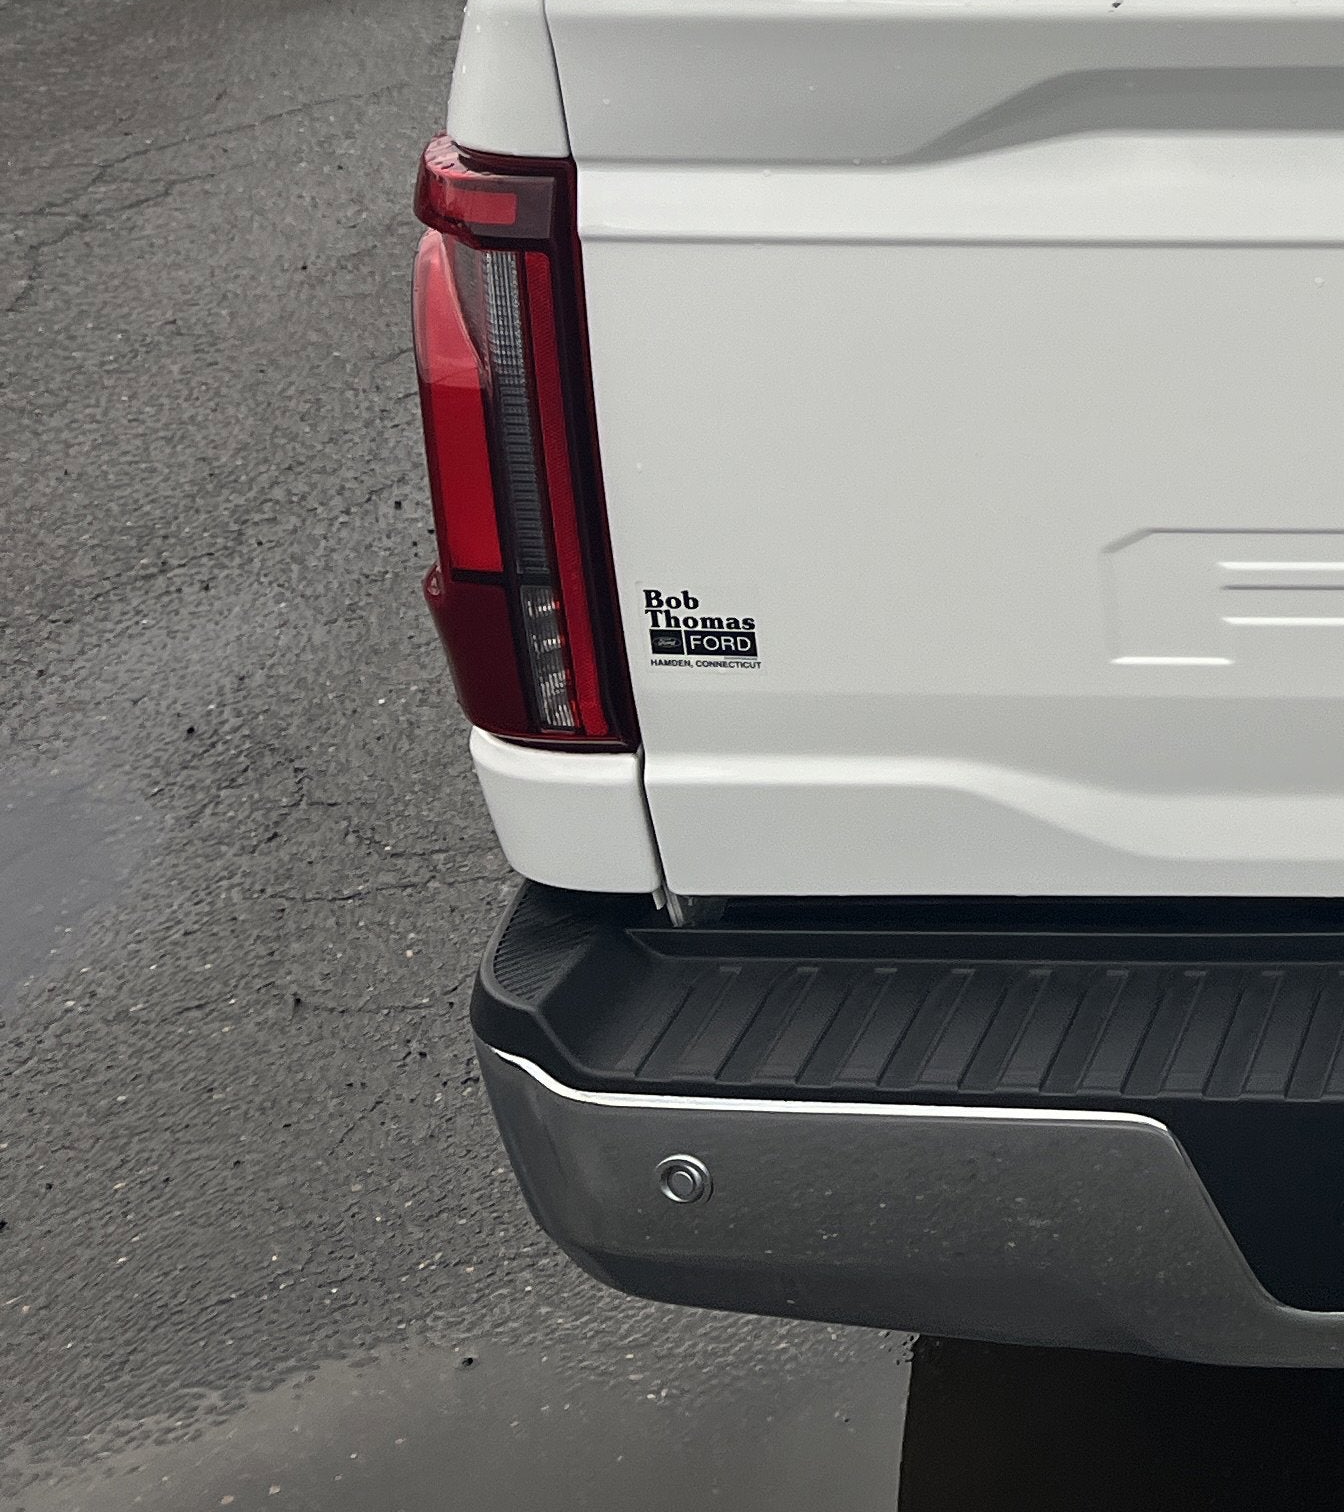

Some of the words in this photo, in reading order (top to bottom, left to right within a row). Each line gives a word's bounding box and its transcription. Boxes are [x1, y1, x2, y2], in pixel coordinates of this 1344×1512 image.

[643, 589, 699, 609] Bob
[645, 609, 756, 630] Thomas
[690, 635, 751, 651] FORD
[651, 658, 693, 668] HAMDEN,
[695, 659, 762, 669] CONNECTICUT
